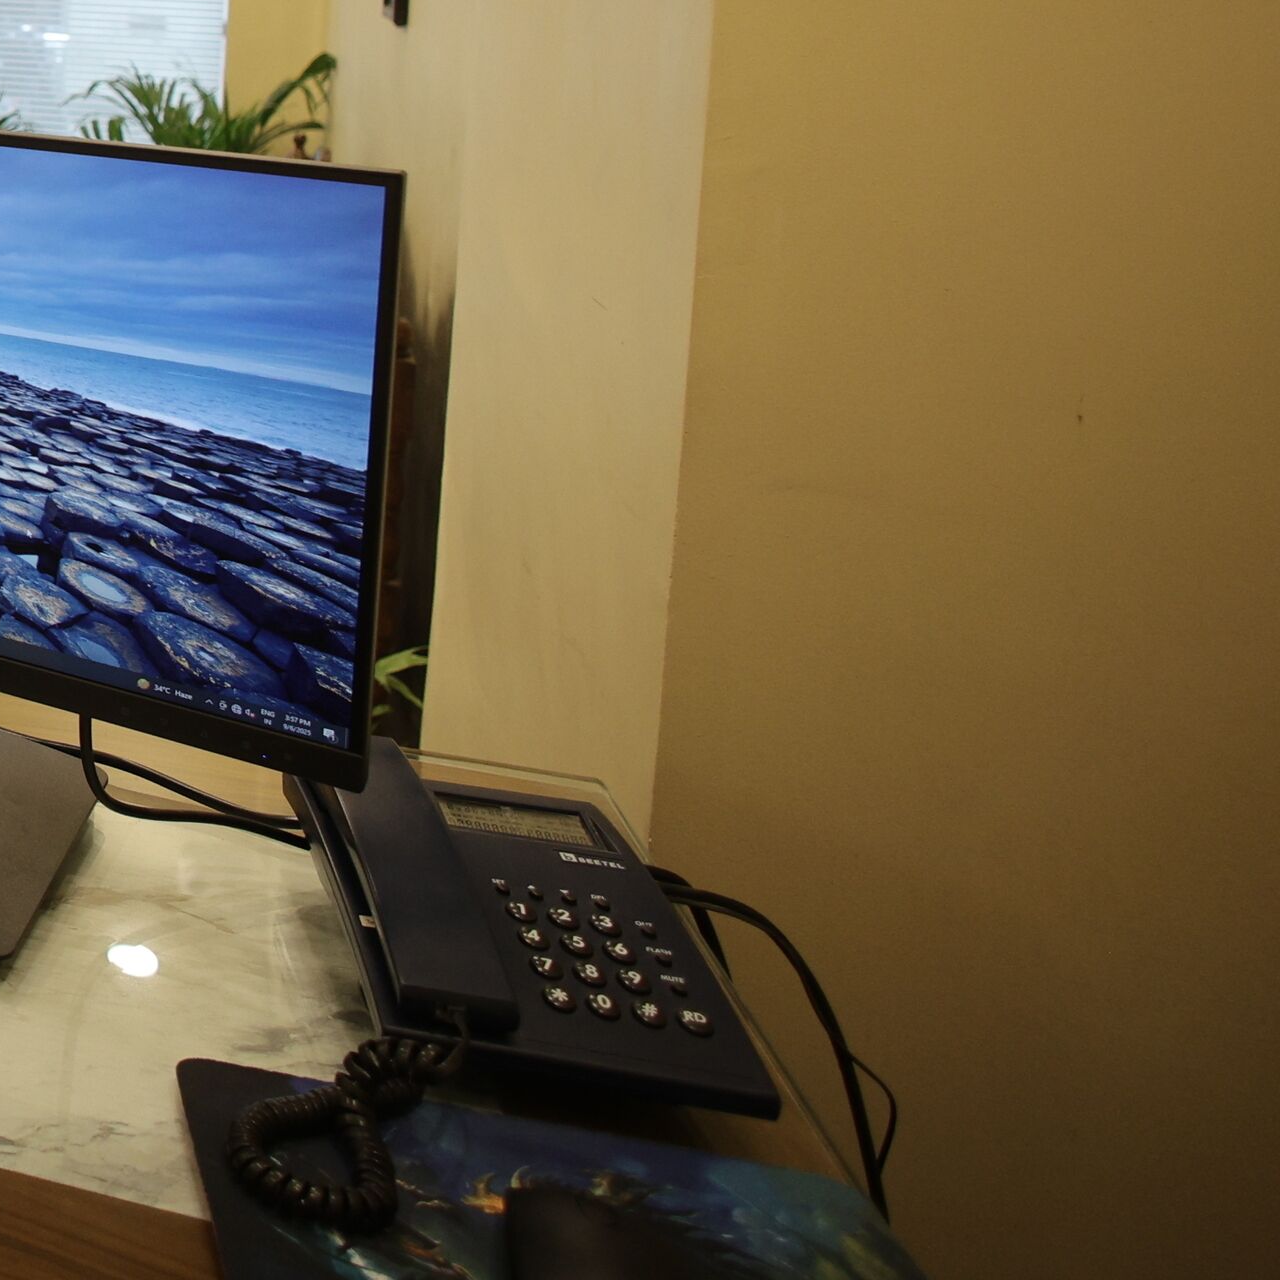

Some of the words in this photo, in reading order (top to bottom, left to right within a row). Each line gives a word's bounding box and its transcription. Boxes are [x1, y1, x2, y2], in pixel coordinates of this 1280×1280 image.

[154, 684, 171, 695] 34°C
[174, 690, 193, 701] Haze
[261, 709, 275, 718] ENG
[299, 718, 311, 727] PM
[578, 857, 625, 869] BEETEL
[516, 903, 526, 915] 1
[557, 909, 571, 921] 2
[598, 915, 613, 927] 3
[527, 929, 540, 940] 4
[572, 935, 584, 948] 5
[615, 942, 628, 955] 6
[646, 946, 672, 956] FLASH
[540, 958, 552, 969] 7
[585, 964, 599, 978] 8
[628, 971, 641, 984] 9
[660, 974, 685, 984] MUTE
[597, 995, 611, 1008] 0
[683, 1011, 707, 1023] RD
